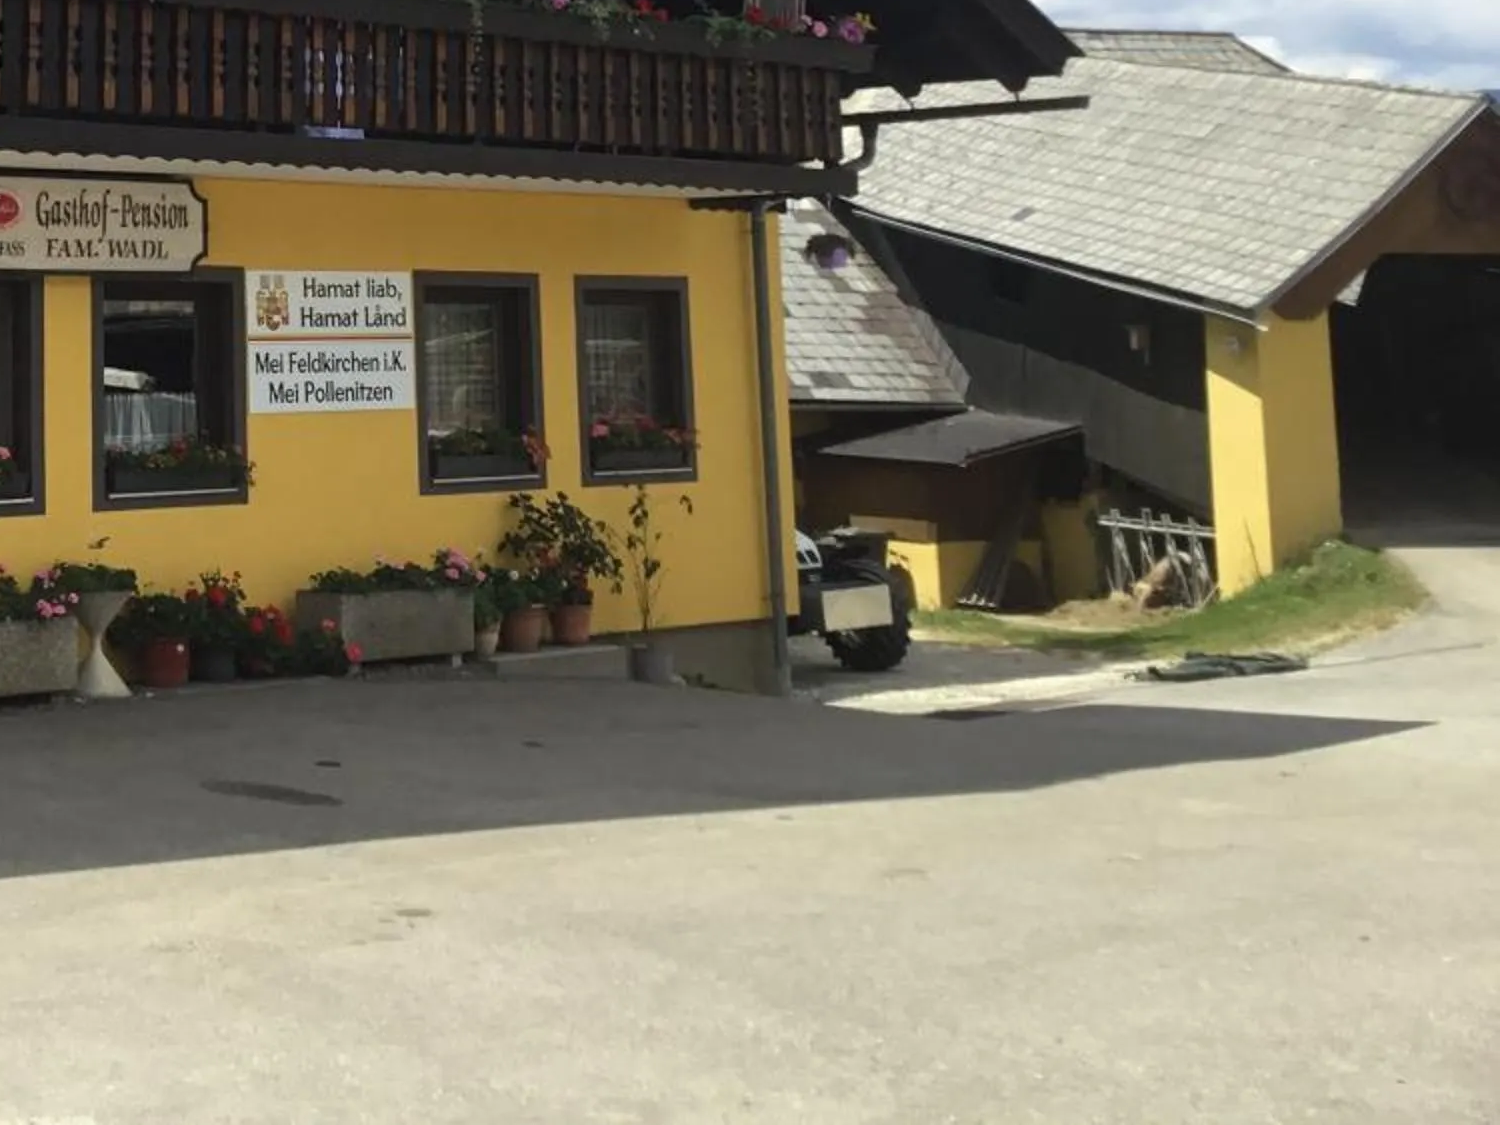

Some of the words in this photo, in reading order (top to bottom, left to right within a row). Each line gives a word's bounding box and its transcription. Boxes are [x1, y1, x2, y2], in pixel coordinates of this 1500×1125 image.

[35, 189, 190, 237] Gasthof-Pension
[0, 240, 26, 257] FASS
[45, 238, 100, 258] FAM.
[108, 238, 169, 260] WADL
[303, 277, 360, 299] Hamat
[367, 279, 403, 302] liab,
[300, 306, 359, 328] Hamat
[255, 352, 284, 374] Mei
[288, 350, 380, 374] Feldkirchen
[383, 350, 407, 372] i.K.
[269, 382, 299, 404] Mei
[304, 380, 393, 404] Pollenitzen
